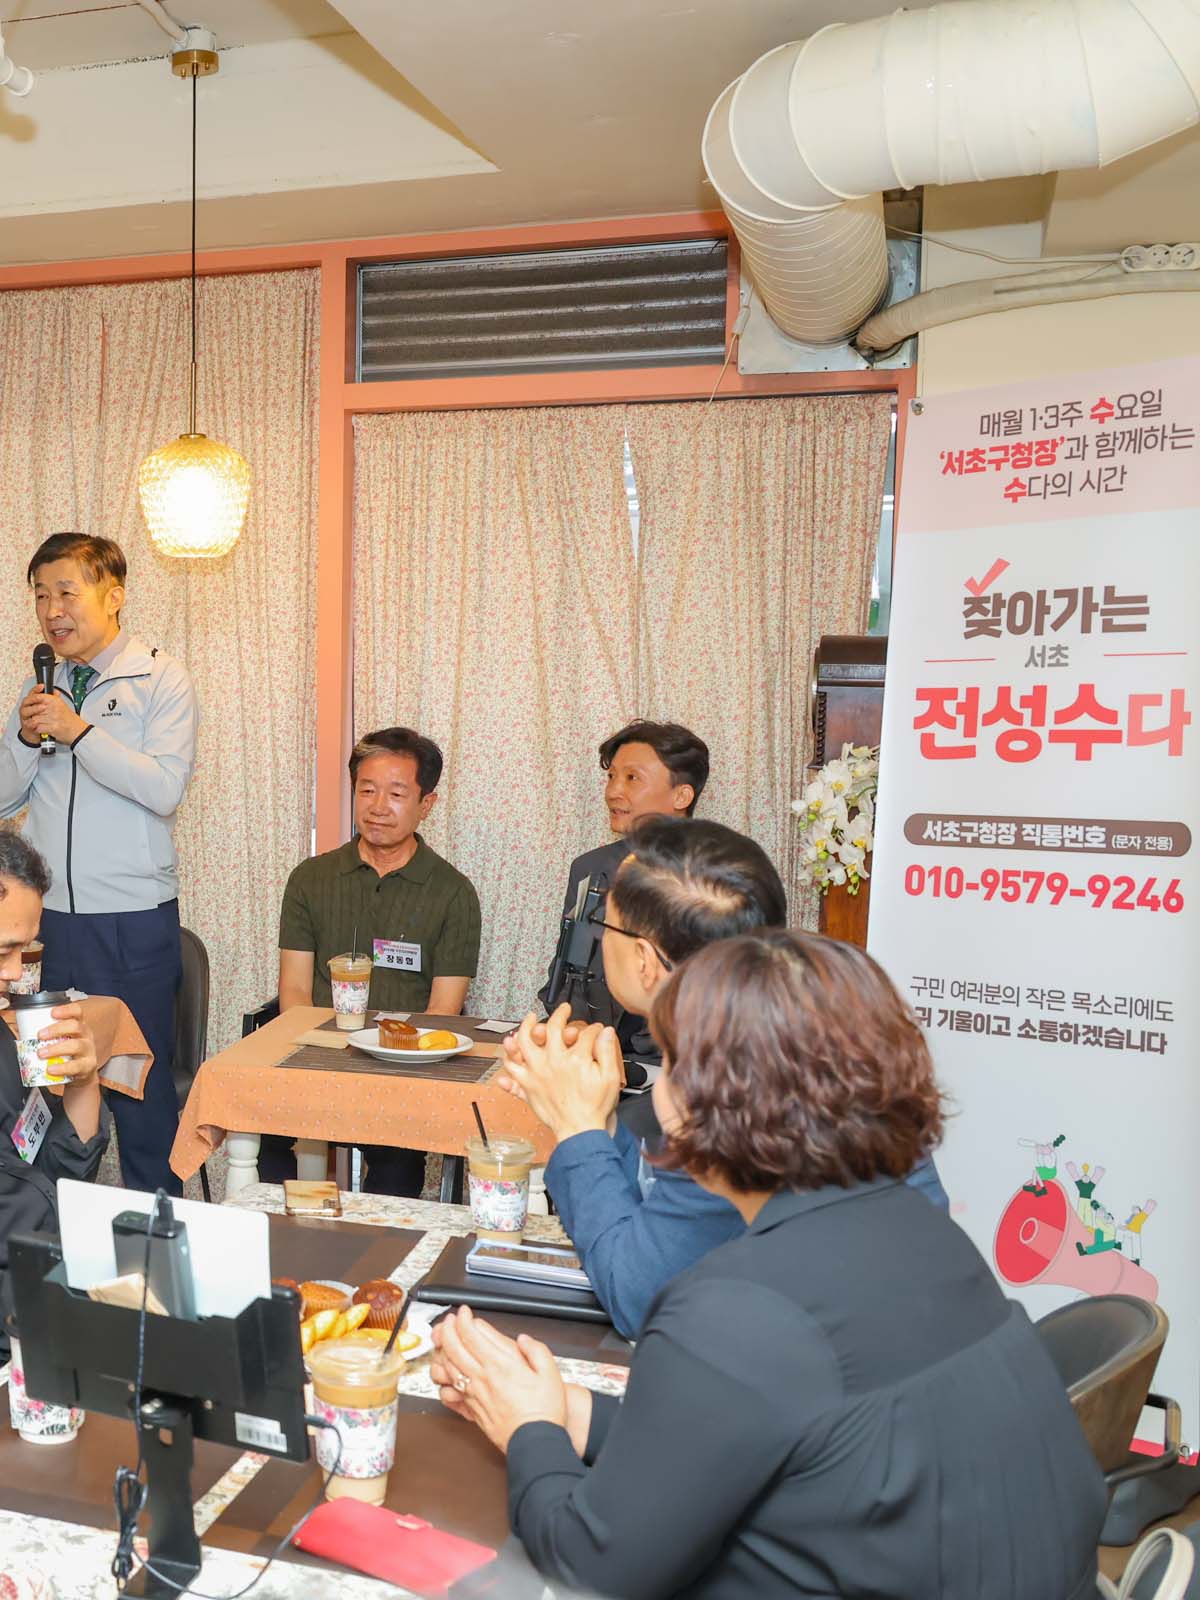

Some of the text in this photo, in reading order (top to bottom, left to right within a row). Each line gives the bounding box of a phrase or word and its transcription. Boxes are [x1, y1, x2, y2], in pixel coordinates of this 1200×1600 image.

[979, 389, 1163, 437] 매월 1·3주 수요일
[1095, 423, 1195, 459] 함께하는
[1003, 465, 1128, 503] 수다의 시간
[962, 586, 1150, 640] 찾아가는
[1024, 644, 1070, 669] 서초
[913, 683, 1192, 763] 전성수다
[921, 819, 1174, 852] 서초구청장 직통번호 (문자 전용)
[904, 864, 1185, 913] 010-9579-9246
[910, 976, 1175, 1022] 구민 여러분의 작은 목소리에도
[936, 1008, 1011, 1037] 기울이고
[1016, 1019, 1168, 1055] 소통하겠습니다
